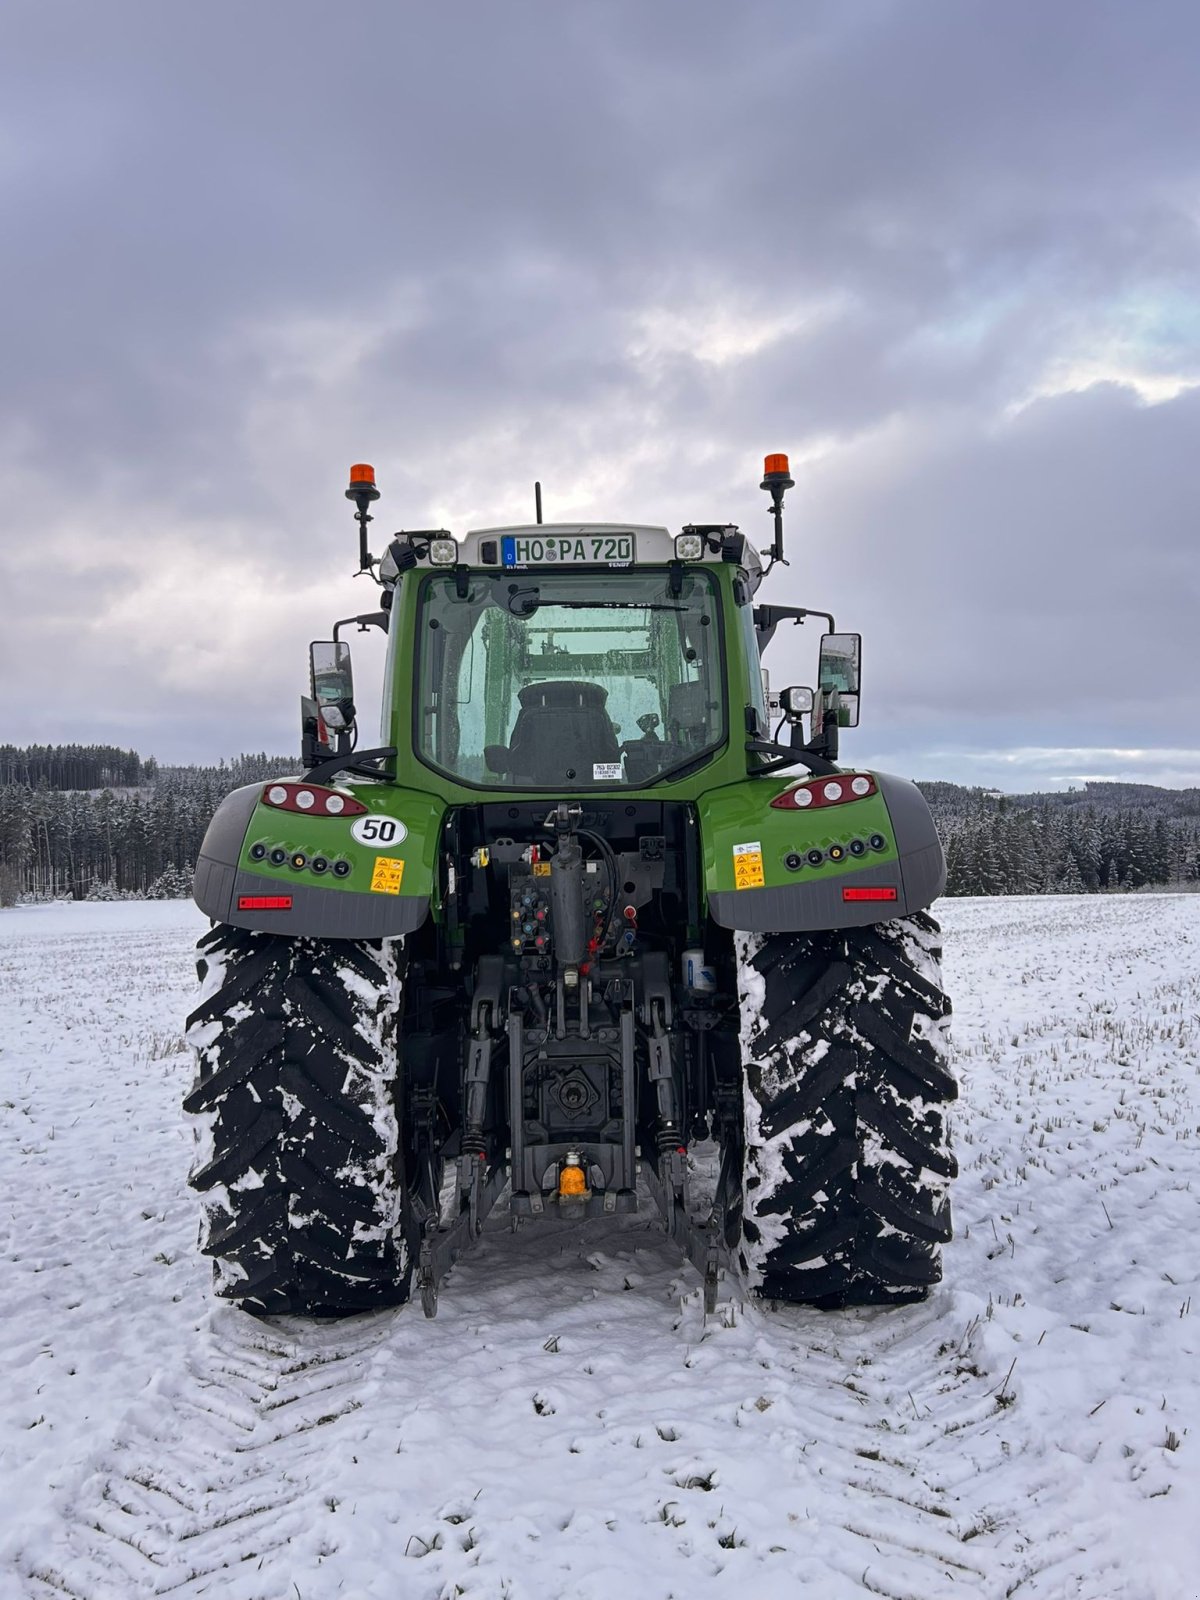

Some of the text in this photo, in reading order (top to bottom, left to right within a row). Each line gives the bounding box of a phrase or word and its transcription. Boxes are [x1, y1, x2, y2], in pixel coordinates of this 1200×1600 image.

[516, 538, 631, 561] HO PA 720
[361, 819, 397, 842] 50
